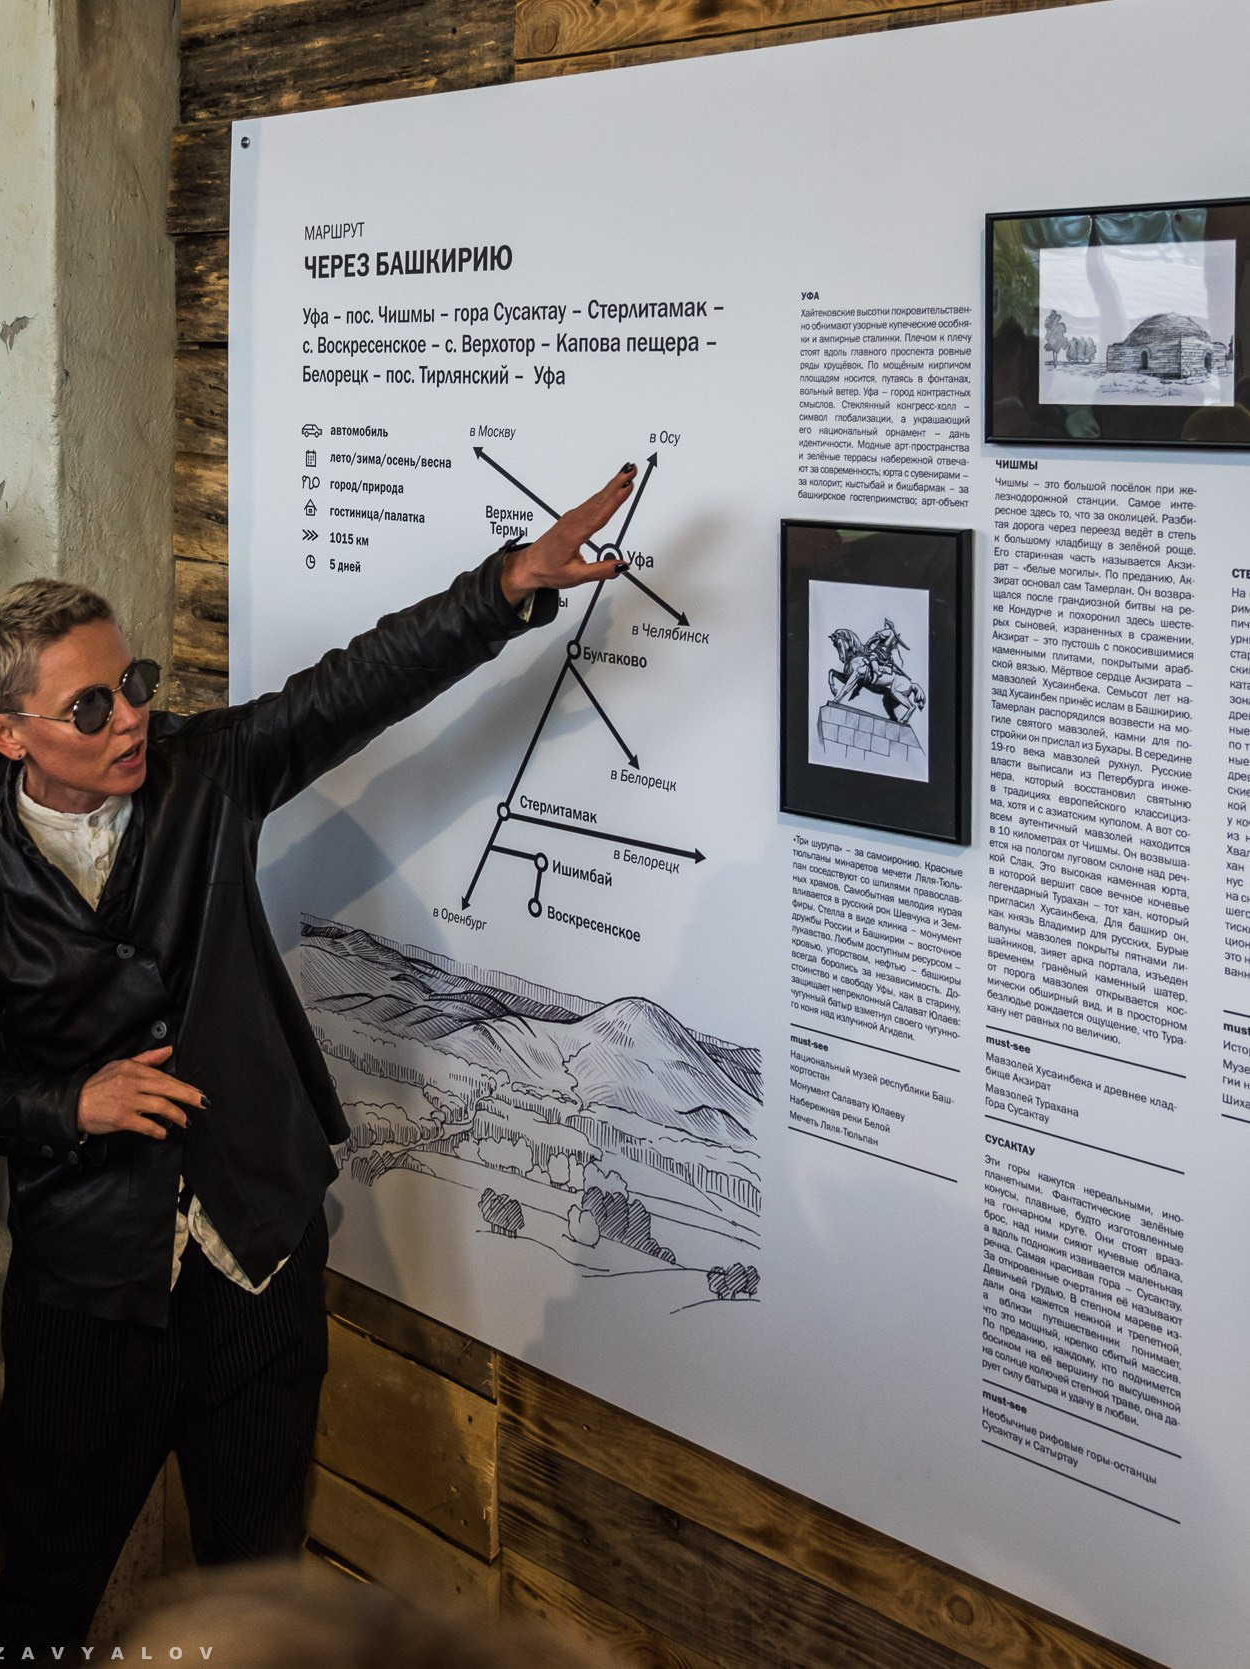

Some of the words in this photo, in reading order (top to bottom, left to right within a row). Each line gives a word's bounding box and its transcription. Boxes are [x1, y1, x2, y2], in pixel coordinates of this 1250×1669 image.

[304, 221, 364, 240] МАРШРУТ
[304, 252, 369, 278] ЧЕРЕЗ
[376, 244, 512, 275] БАШКИРИЮ
[801, 291, 819, 300] УФА
[302, 307, 328, 328] Уфа
[346, 310, 373, 323] пос.
[378, 305, 434, 323] Чишмы
[454, 306, 488, 325] гора
[493, 302, 566, 325] Сусактау
[587, 299, 707, 322] Стерлитамак
[800, 308, 855, 317] Хайтековские
[856, 308, 889, 316] высотки
[891, 306, 972, 316] покровительствен-
[811, 321, 851, 330] обнимают
[852, 322, 887, 331] узорные
[888, 320, 936, 330] купеческие
[937, 319, 971, 328] особня-
[302, 340, 312, 353] с.
[317, 336, 426, 357] Воскресенское
[445, 339, 456, 352] с.
[462, 334, 535, 357] Верхотор
[556, 333, 620, 352] Капова
[626, 336, 698, 356] пещера
[819, 335, 860, 344] ампирные
[904, 333, 936, 342] Плечом
[947, 334, 972, 343] плечу
[824, 349, 847, 357] вдоль
[850, 348, 887, 356] главного
[890, 348, 934, 357] проспекта
[938, 348, 971, 356] ровные
[302, 365, 368, 386] Белорецк
[386, 369, 414, 383] пос.
[418, 364, 508, 387] Тирлянский
[533, 365, 564, 389] Уфа
[800, 362, 819, 370] ряды
[823, 362, 863, 371] хрущёвок.
[867, 360, 878, 369] По
[882, 360, 923, 370] мощёным
[928, 361, 971, 370] кирпичом
[330, 425, 388, 437] автомобиль
[469, 427, 475, 436] в
[478, 424, 516, 440] Москву
[649, 433, 656, 443] в
[659, 430, 680, 446] Осу
[329, 452, 451, 469] лето/зима/осень/весна
[995, 459, 1037, 469] ЧИШМЫ
[330, 480, 403, 495] город/природа
[995, 477, 1028, 487] Чишмы
[1044, 481, 1059, 489] это
[1063, 480, 1105, 490] большой
[1110, 482, 1151, 493] посёлок
[1155, 485, 1174, 495] при
[1178, 487, 1196, 495] же-
[994, 493, 1067, 503] лезнодорожной
[1076, 497, 1118, 506] станции.
[1127, 497, 1160, 508] Самое
[1170, 501, 1196, 510] инте-
[330, 507, 424, 523] гостиница/палатка
[485, 505, 533, 522] Верхние
[994, 507, 1026, 515] ресное
[1029, 508, 1056, 517] здесь
[1059, 510, 1071, 518] то,
[1074, 511, 1090, 519] что
[1093, 512, 1104, 520] за
[1107, 512, 1157, 523] околицей.
[1161, 513, 1196, 524] Разби-
[329, 532, 353, 544] 1015
[356, 536, 368, 545] км
[490, 521, 528, 538] Термы
[329, 558, 335, 569] 5
[337, 561, 360, 572] дней
[626, 550, 653, 570] Уфа
[631, 625, 638, 635] в
[642, 622, 709, 644] Челябинск
[583, 645, 646, 668] Булгаково
[610, 769, 617, 780] в
[620, 768, 676, 792] Белорецк
[520, 795, 596, 823] Стерлитамак
[552, 859, 612, 886] Ишимбай
[613, 849, 620, 859] в
[623, 849, 679, 874] Белорецк
[432, 907, 438, 917] в
[441, 907, 486, 931] Оренбург
[547, 905, 640, 942] Воскресенское
[790, 1035, 828, 1051] must-see
[986, 1036, 1030, 1053] must-see
[790, 1064, 829, 1081] кортостан
[790, 1049, 850, 1074] Национальный
[852, 1069, 877, 1082] музей
[879, 1077, 929, 1097] республики
[932, 1090, 953, 1104] Баш-
[985, 1065, 1010, 1080] бище
[1012, 1072, 1051, 1090] Акзират
[985, 1051, 1033, 1072] Мавзолей
[1035, 1064, 1092, 1088] Хусаинбека
[1103, 1085, 1146, 1102] древнее
[1149, 1097, 1176, 1111] клад-
[789, 1077, 830, 1097] Монумент
[831, 1091, 869, 1111] Салавату
[871, 1103, 905, 1122] Юлаеву
[985, 1082, 1032, 1104] Мавзолей
[1035, 1096, 1078, 1117] Турахана
[985, 1096, 1005, 1110] Гора
[1007, 1102, 1049, 1124] Сусактау
[789, 1094, 840, 1117] Набережная
[842, 1112, 862, 1124] реки
[864, 1117, 890, 1132] Белой
[789, 1109, 818, 1126] Мечеть
[820, 1120, 878, 1146] Ляля-Тюльпан
[985, 1133, 1035, 1155] СУСАКТАУ
[984, 1154, 1000, 1166] Эти
[1007, 1163, 1030, 1176] горы
[1037, 1172, 1075, 1190] кажутся
[1083, 1186, 1153, 1215] нереальными,
[1162, 1210, 1183, 1222] ино-
[984, 1169, 1042, 1194] планетными.
[1052, 1189, 1130, 1221] Фантастические
[1140, 1218, 1184, 1238] зелёные
[982, 1390, 1027, 1413] must-see
[981, 1419, 1023, 1445] Сусактау
[1025, 1438, 1030, 1446] и
[1032, 1440, 1078, 1467] Сатыртау
[982, 1405, 1037, 1435] Необычные
[1039, 1430, 1083, 1454] рифовые
[1086, 1449, 1156, 1484] горы-останцы
